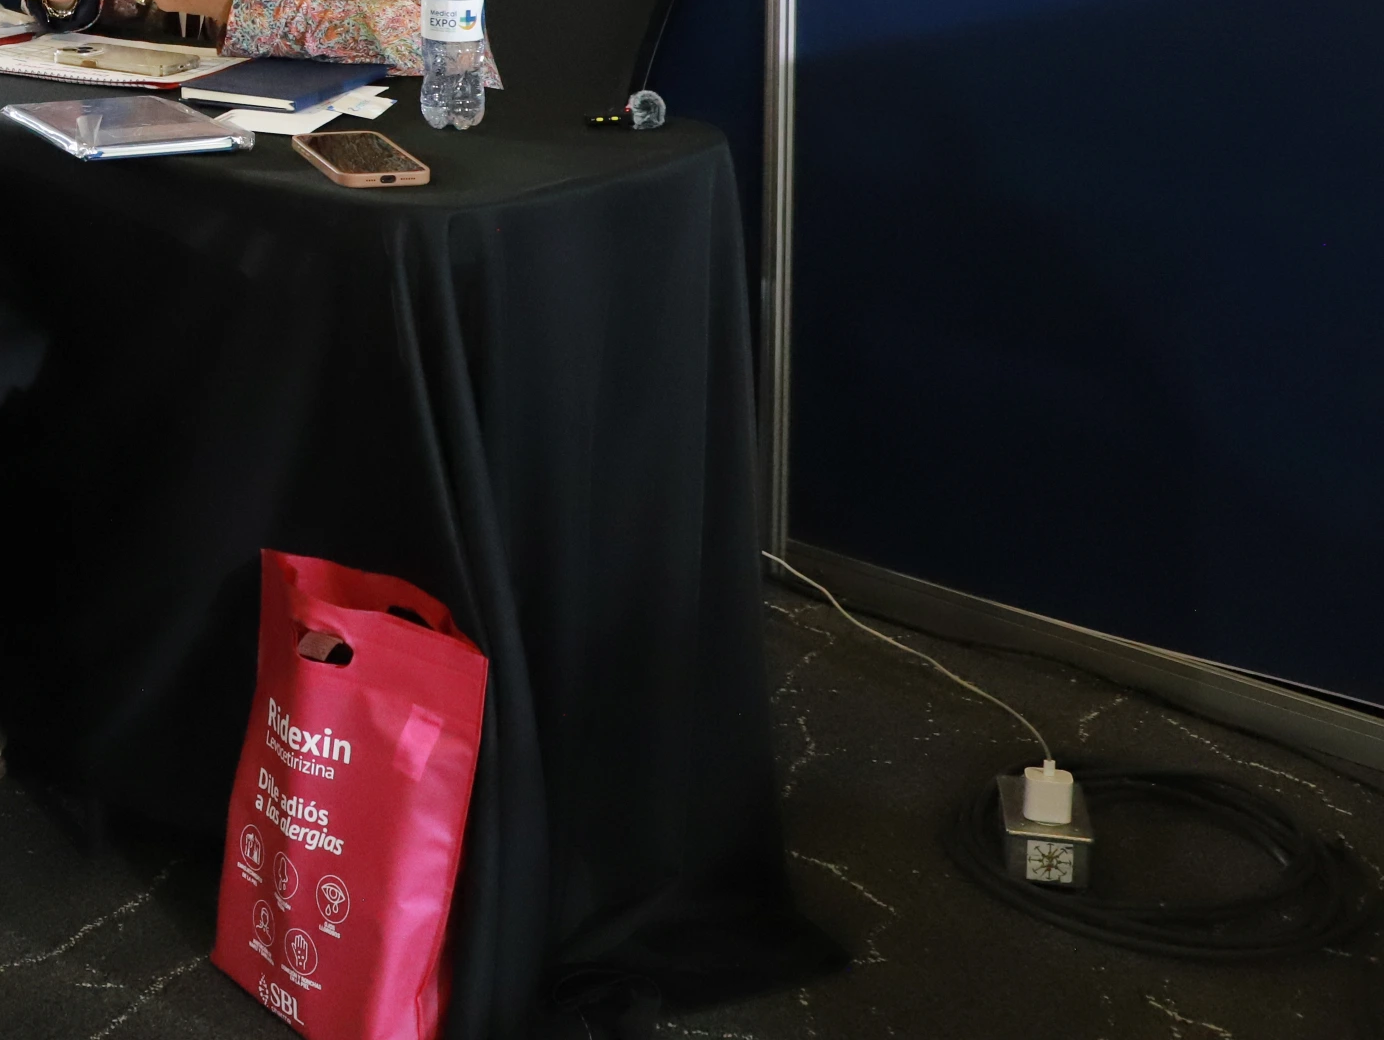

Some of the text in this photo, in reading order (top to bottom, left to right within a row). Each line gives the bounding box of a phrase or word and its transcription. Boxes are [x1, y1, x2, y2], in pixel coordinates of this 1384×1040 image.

[430, 9, 457, 18] Medical
[430, 17, 457, 28] EXPO
[266, 730, 335, 780] Levocetirizina
[268, 697, 351, 764] Ridexin
[258, 767, 329, 826] Dile adiós
[255, 794, 344, 856] a las alergias
[270, 982, 305, 1026] SBL
